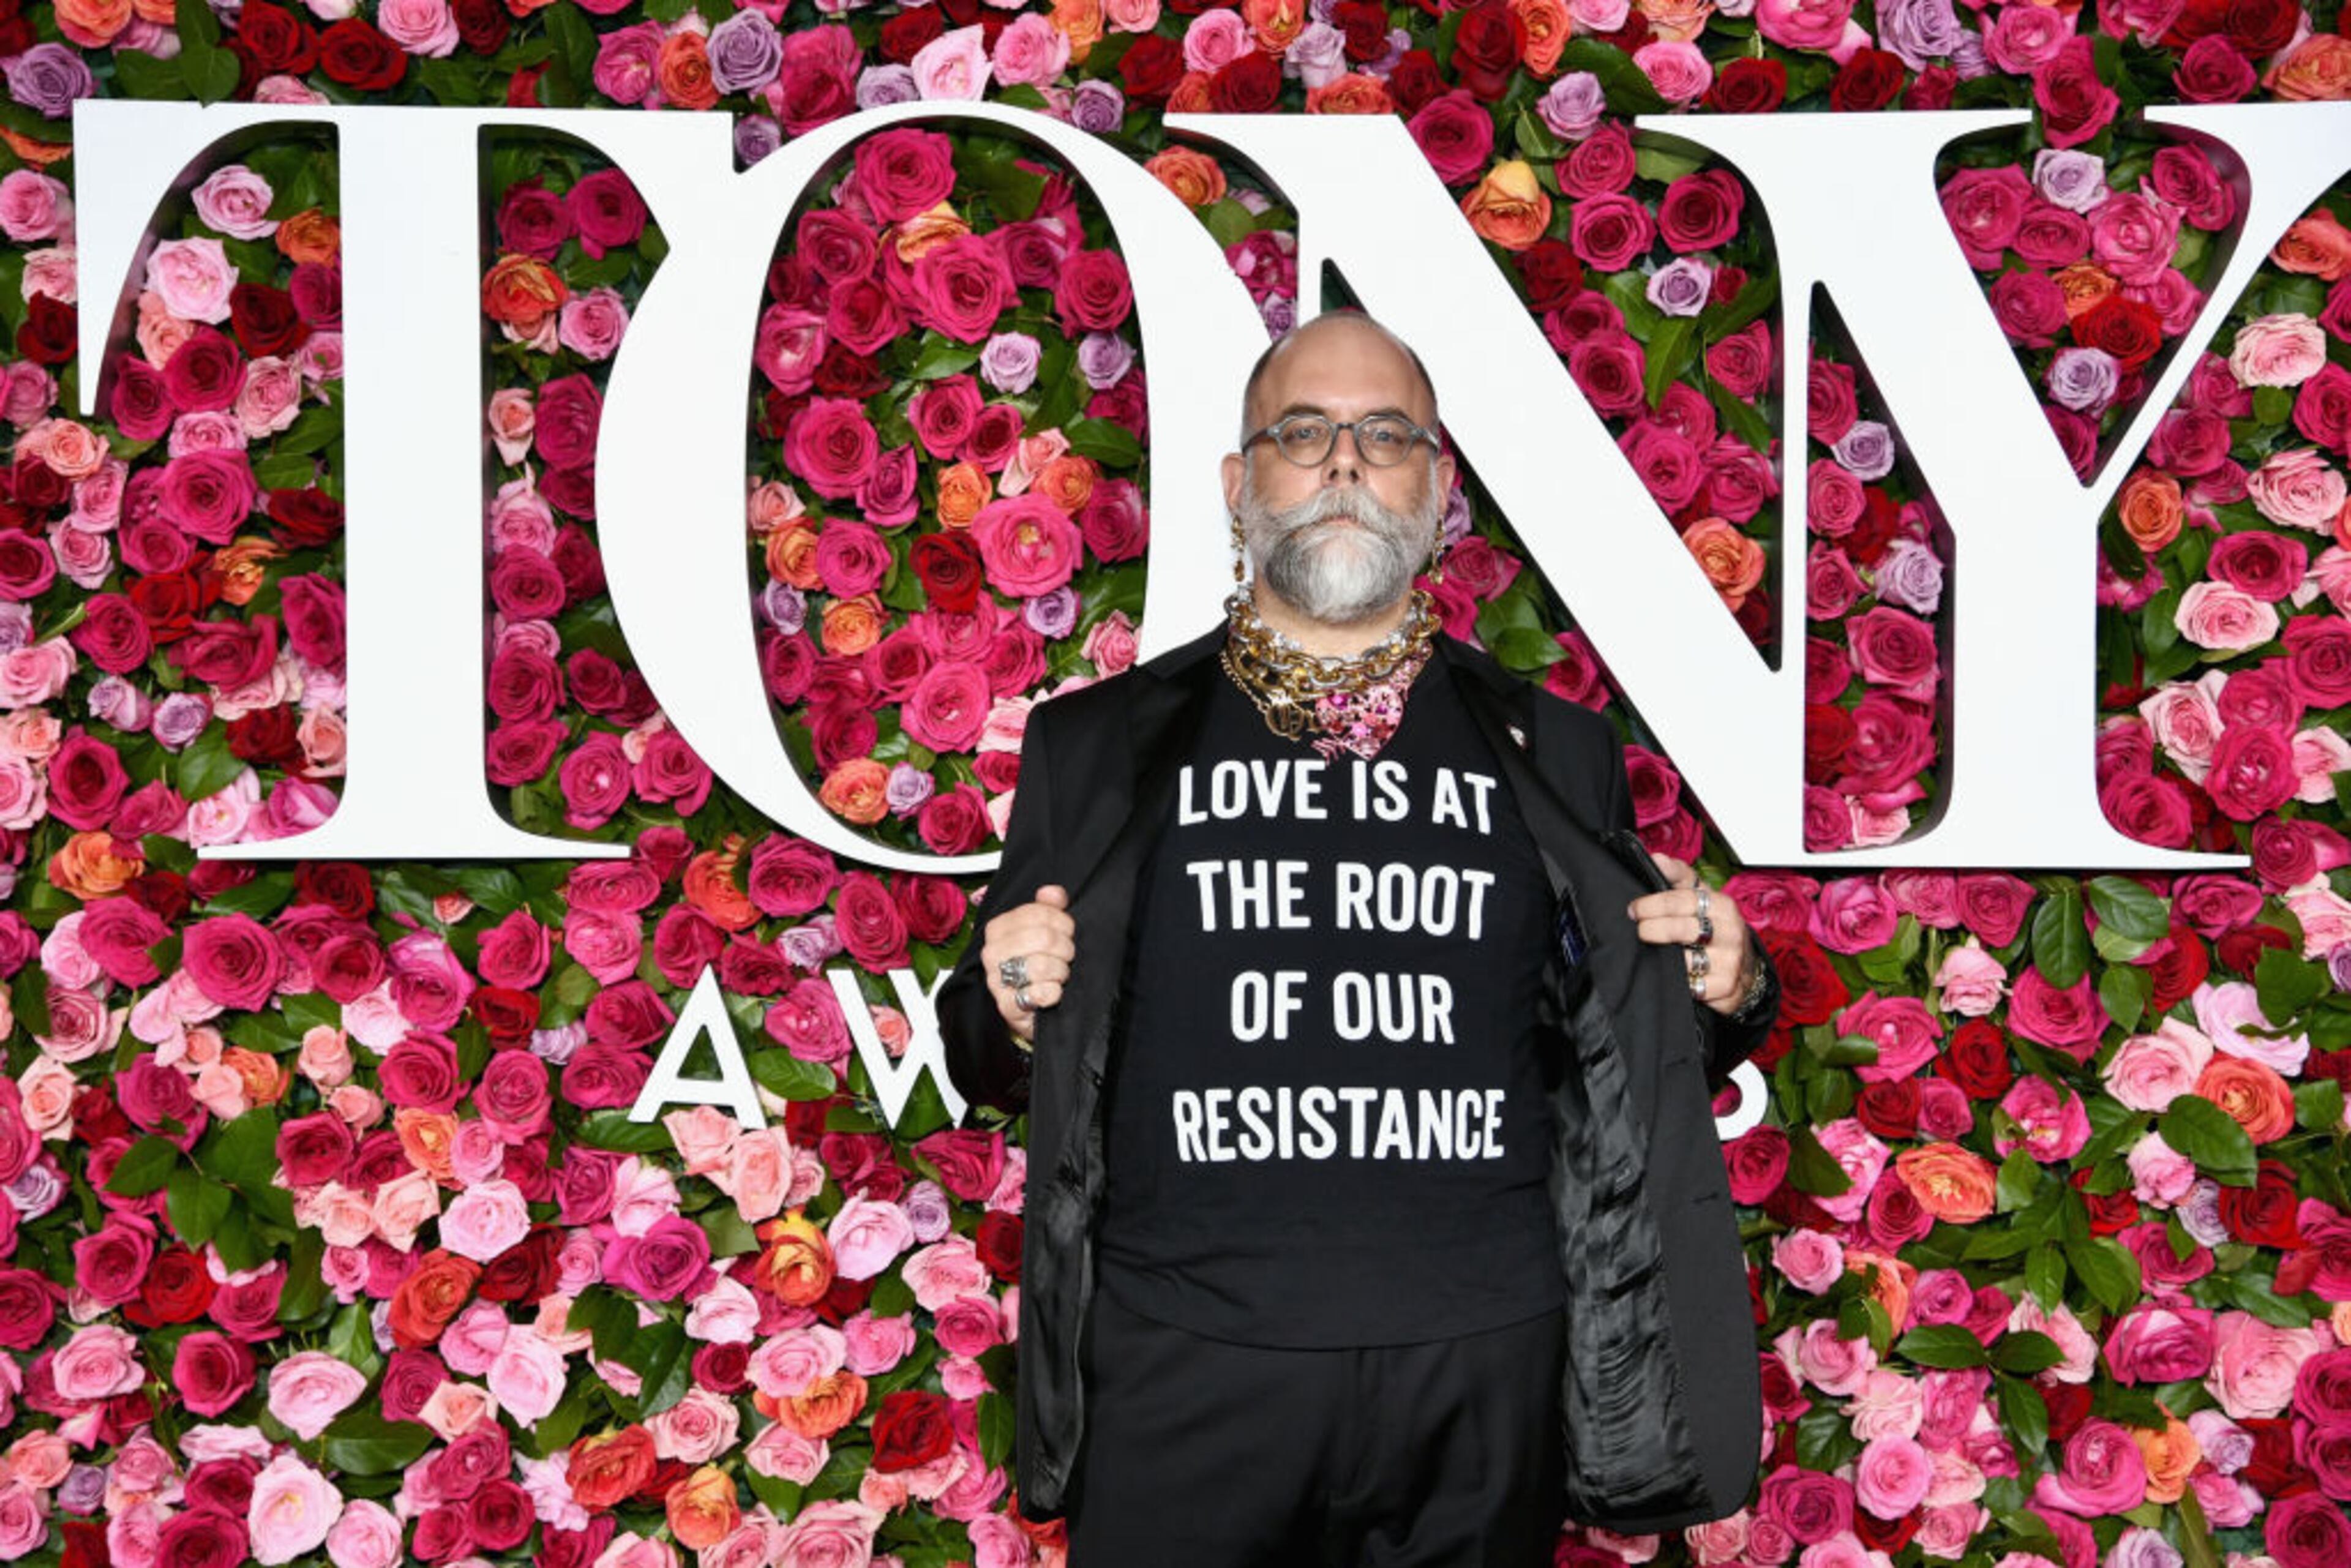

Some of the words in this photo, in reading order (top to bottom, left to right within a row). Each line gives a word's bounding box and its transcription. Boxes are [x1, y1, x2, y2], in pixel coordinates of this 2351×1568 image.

[73, 99, 2351, 873] TONY
[1179, 759, 1327, 825] LOVE
[1352, 760, 1409, 821] IS
[1432, 768, 1496, 835] AT
[1187, 860, 1311, 931] THE
[1337, 862, 1495, 940] ROOT
[1231, 971, 1307, 1041] OF
[1333, 972, 1454, 1044] OUR
[1173, 1086, 1505, 1161] RESISTANCE
